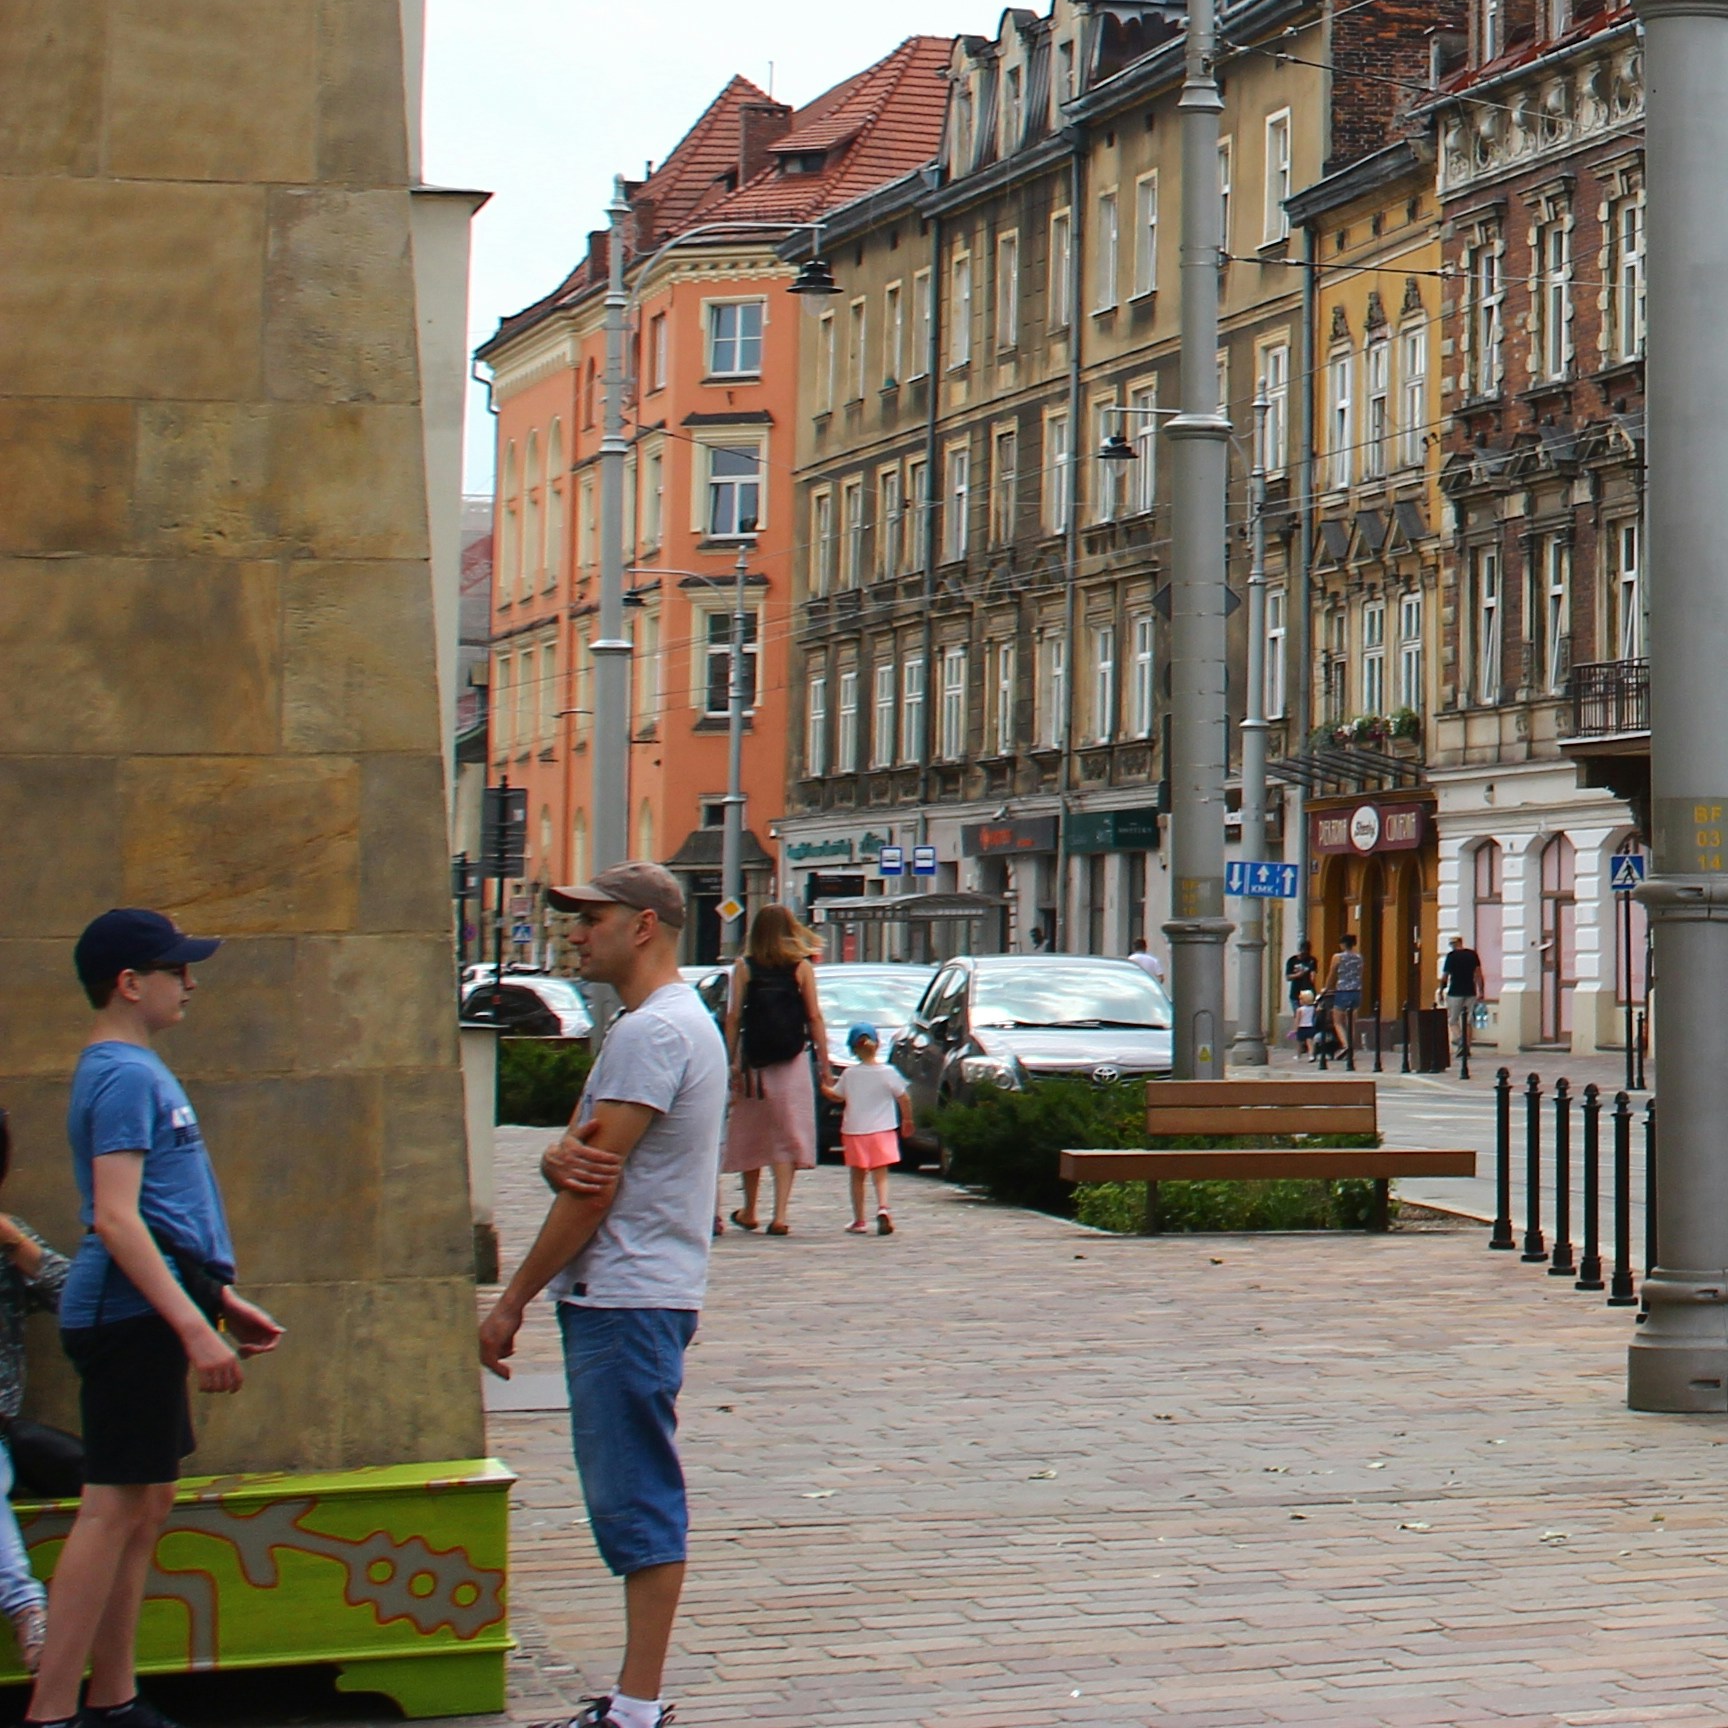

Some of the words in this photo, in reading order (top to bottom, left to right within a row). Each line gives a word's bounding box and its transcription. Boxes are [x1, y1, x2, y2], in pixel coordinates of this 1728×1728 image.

[1693, 805, 1722, 824] BF
[1696, 829, 1722, 848] 03
[1696, 854, 1723, 871] 14
